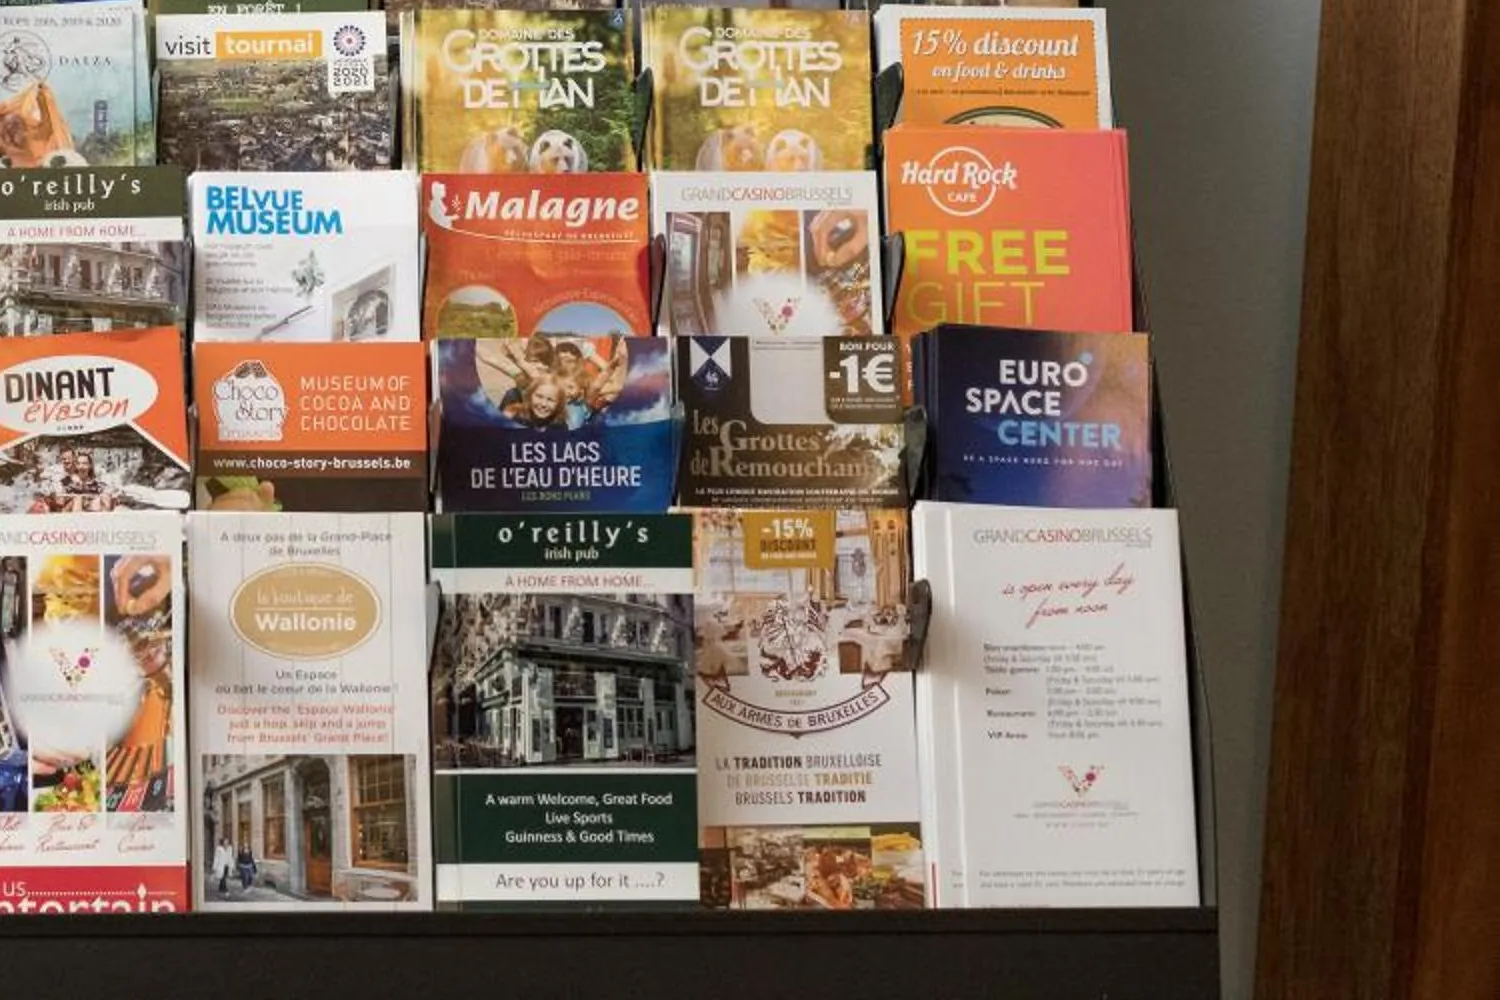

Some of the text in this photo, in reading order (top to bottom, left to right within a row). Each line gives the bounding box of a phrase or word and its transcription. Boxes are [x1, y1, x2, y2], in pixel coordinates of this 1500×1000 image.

[1, 174, 141, 198] o'reilly's
[901, 160, 1017, 191] Hard Rock
[44, 199, 94, 213] irish pub
[206, 186, 302, 211] BELVUE
[947, 192, 976, 204] CAFE
[206, 210, 342, 235] MUSEUM
[906, 229, 1069, 275] FREE
[908, 280, 1043, 327] GIFT
[1001, 358, 1088, 386] EURO
[966, 389, 1061, 416] SPACE
[692, 410, 821, 453] Les Grottes
[998, 421, 1121, 448] CENTER
[511, 441, 600, 463] LES LACS
[213, 455, 411, 471] www.choco-story-brussels.be
[321, 532, 392, 543] Grand-Place
[761, 518, 813, 539] -15%
[760, 537, 817, 553] DISCOUNT
[506, 576, 514, 587] A
[518, 576, 557, 587] HOME
[561, 576, 599, 587] FROM
[255, 612, 357, 633] Wallonie
[713, 693, 736, 714] AUX
[739, 706, 784, 728] ARMES
[806, 691, 880, 727] BRUXELLES
[715, 755, 882, 769] LA TRADITION BRUXELLOISE
[735, 791, 866, 805] BRUSSELS TRADITION
[3, 882, 26, 897] us
[495, 872, 629, 892] Are you up for it
